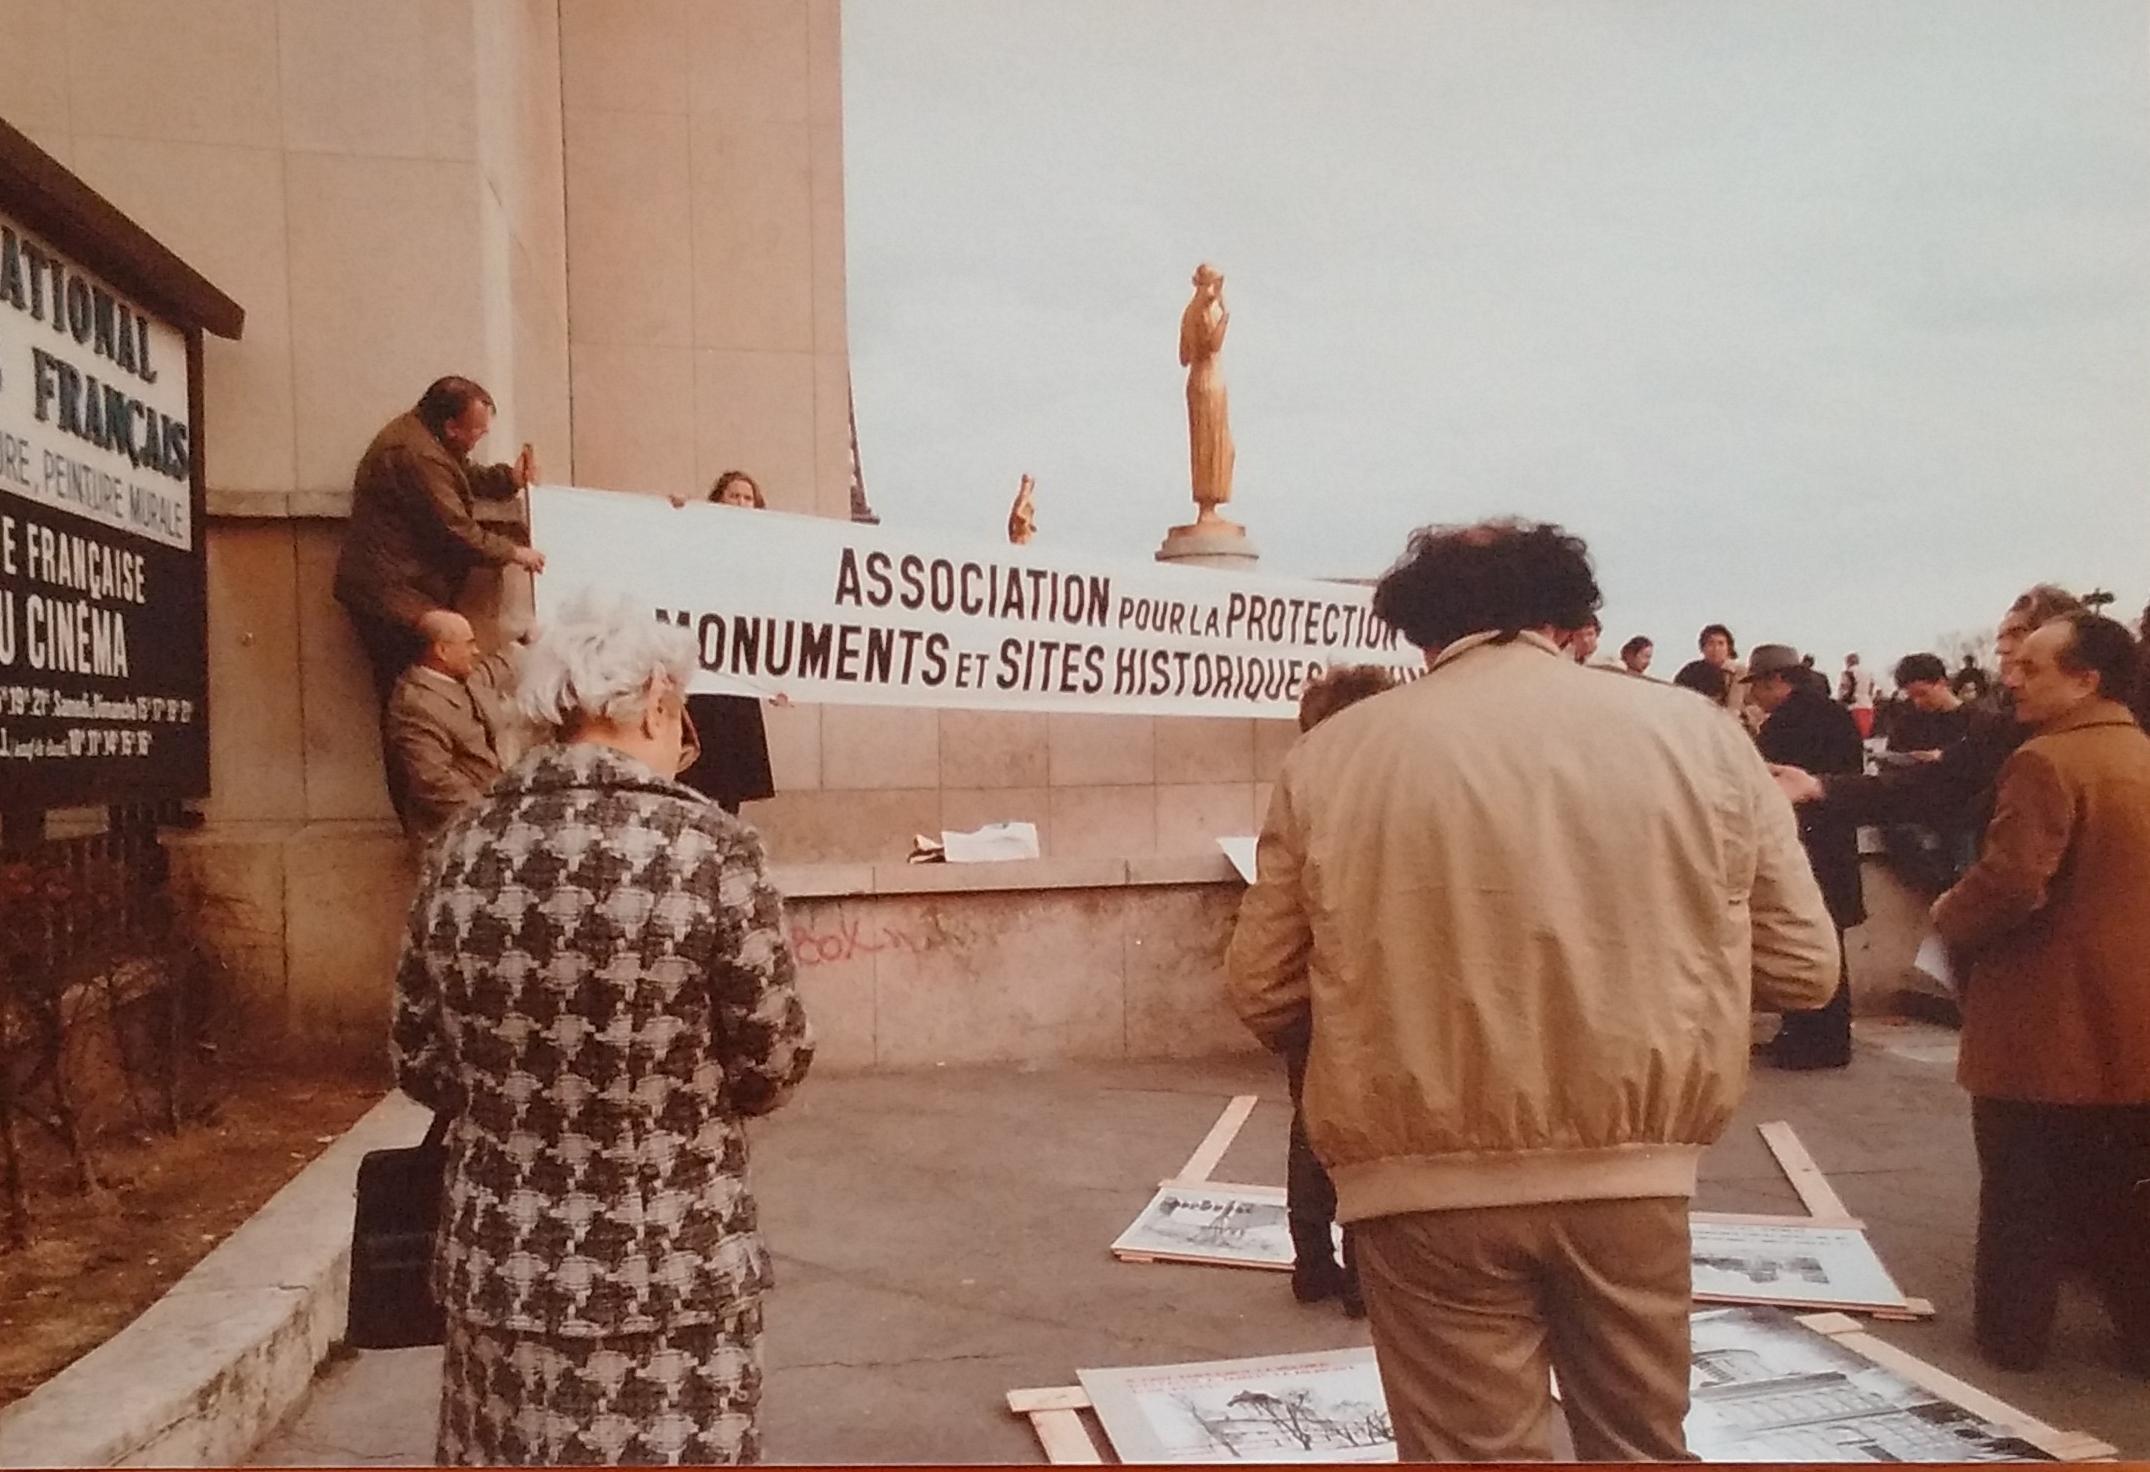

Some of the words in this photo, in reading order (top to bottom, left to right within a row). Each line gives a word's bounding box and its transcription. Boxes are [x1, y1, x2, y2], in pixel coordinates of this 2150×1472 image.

[32, 346, 189, 482] FRANÇAIS
[26, 522, 146, 604] FRANÇAISE
[835, 547, 1110, 628] ASSOCIATION
[1119, 597, 1192, 636] POUR
[1190, 606, 1221, 638] LA
[26, 593, 130, 678] CINÉMA
[655, 608, 948, 687] ONUMENTS
[955, 652, 990, 689] ET
[996, 637, 1104, 695] SITES
